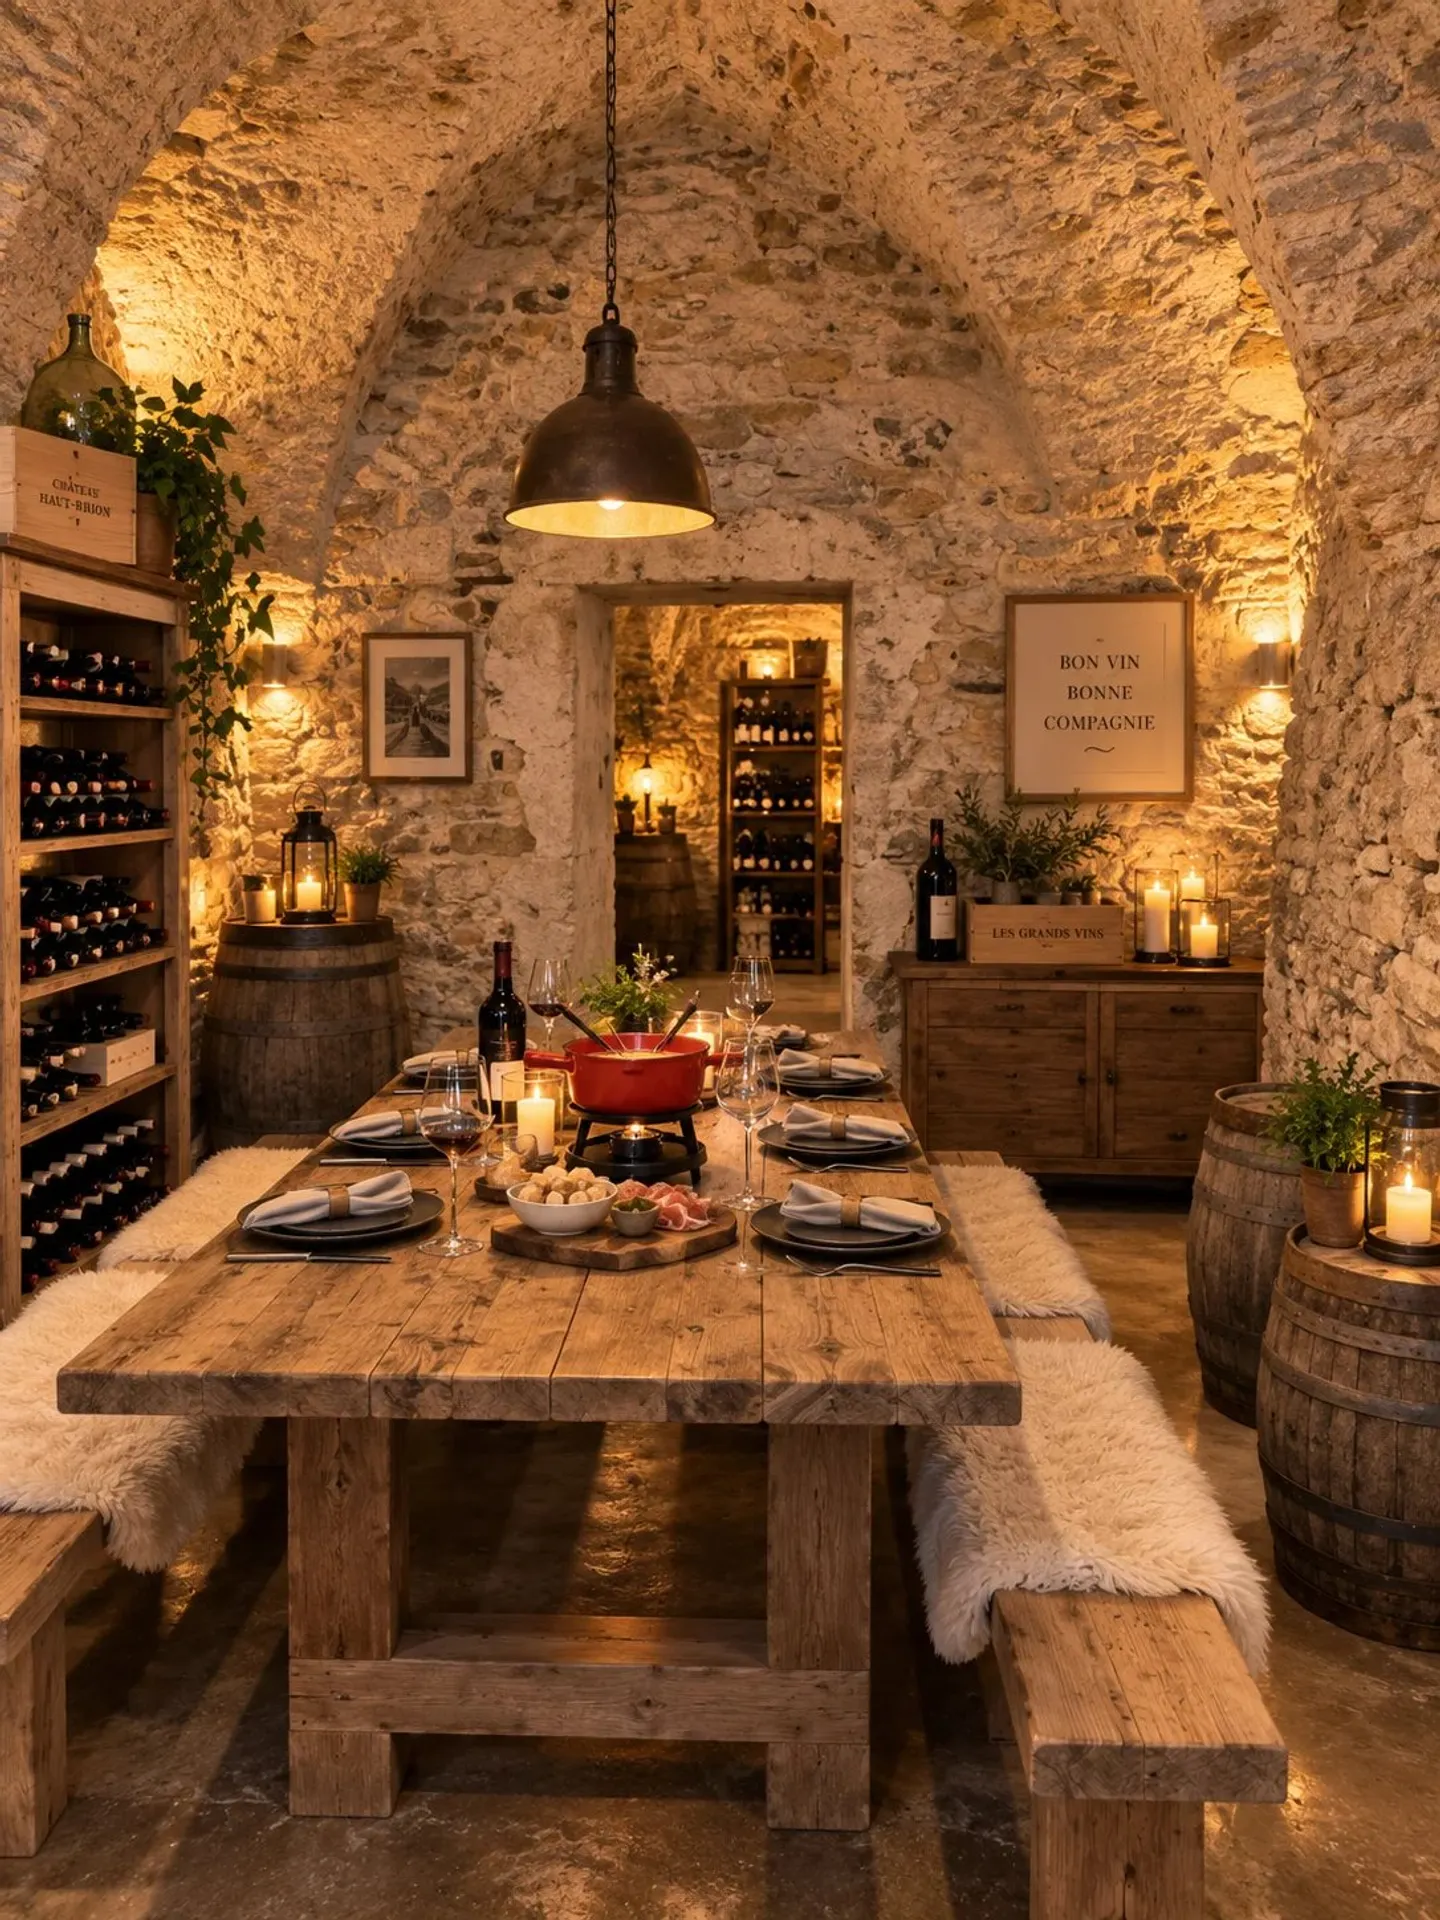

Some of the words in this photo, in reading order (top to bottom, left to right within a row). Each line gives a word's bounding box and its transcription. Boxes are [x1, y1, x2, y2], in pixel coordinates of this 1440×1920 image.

[39, 493, 111, 518] HAUT-BRION
[1060, 655, 1099, 670] BON
[1107, 655, 1140, 670] VIN
[1068, 685, 1133, 700] BONNE
[1044, 715, 1156, 730] COMPAGNIE
[992, 928, 1016, 939] LES
[1018, 928, 1071, 939] GRANDS
[1074, 928, 1105, 939] VINS
